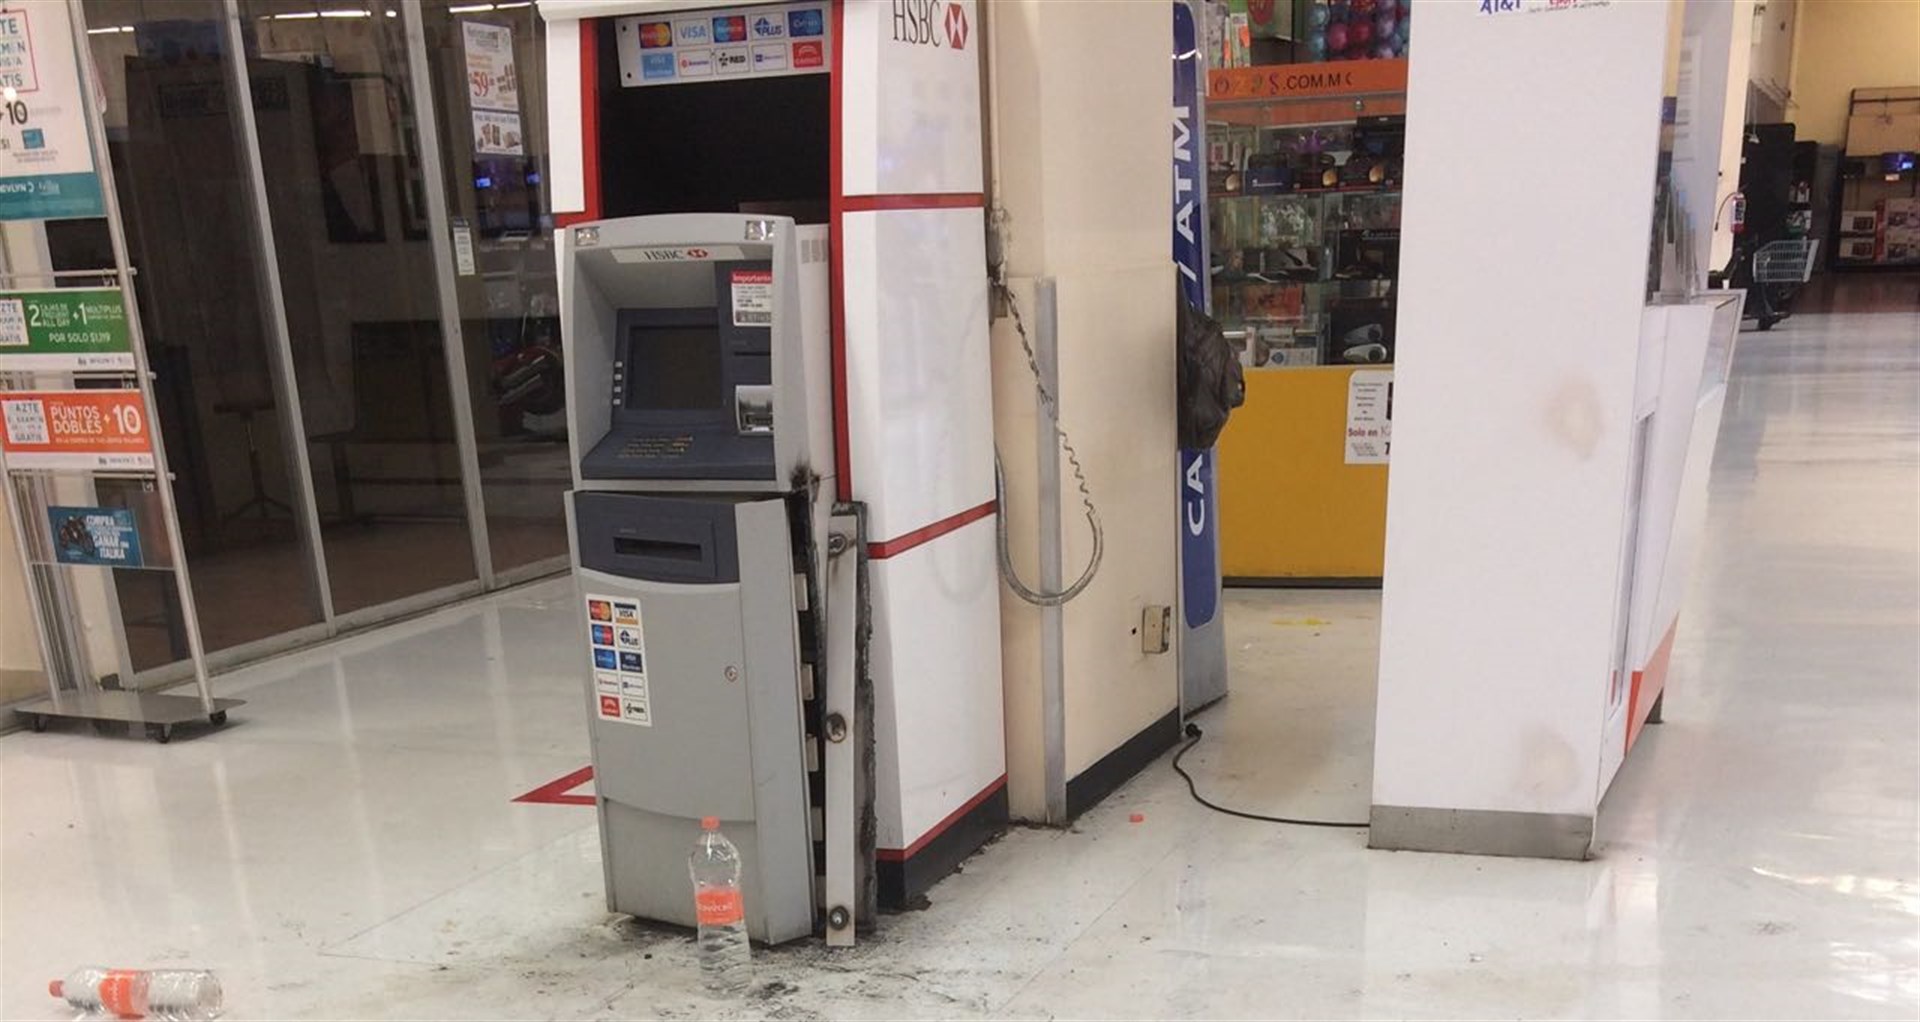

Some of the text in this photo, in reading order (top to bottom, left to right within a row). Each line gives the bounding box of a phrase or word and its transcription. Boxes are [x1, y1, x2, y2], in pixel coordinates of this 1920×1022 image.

[762, 26, 782, 35] PLUS
[893, 0, 941, 47] HSBC
[680, 28, 706, 39] VISA
[6, 101, 28, 125] 10
[1173, 105, 1195, 243] ATM
[642, 250, 685, 260] HSBC
[28, 304, 41, 327] 2
[79, 302, 87, 325] 1
[49, 332, 66, 342] POR
[67, 332, 88, 342] SOLO
[50, 405, 100, 420] PUNTOS
[113, 404, 142, 435] 10
[53, 419, 103, 435] DOBLES
